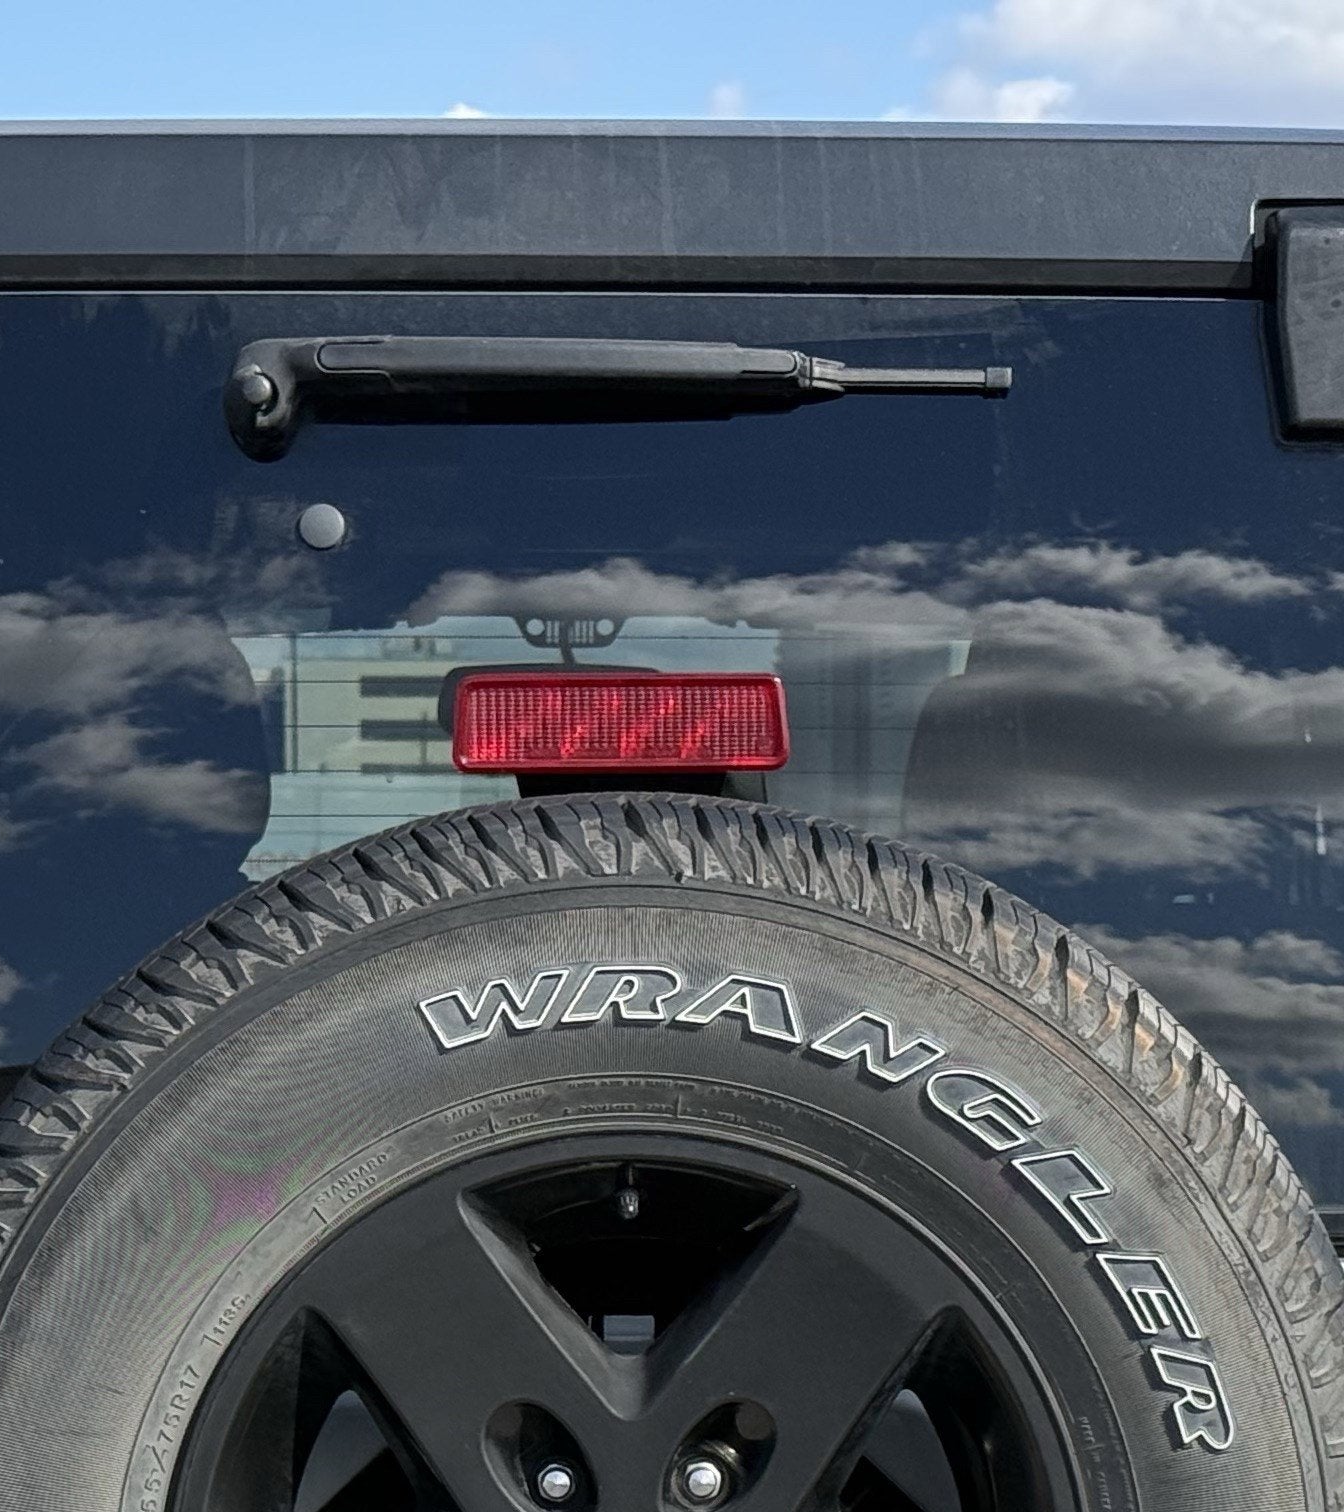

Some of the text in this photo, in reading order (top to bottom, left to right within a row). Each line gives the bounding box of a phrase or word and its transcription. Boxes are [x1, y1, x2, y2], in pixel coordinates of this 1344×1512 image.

[312, 1150, 390, 1208] STANDARD
[337, 1172, 379, 1205] LOAD
[419, 963, 1236, 1451] WRANGLER
